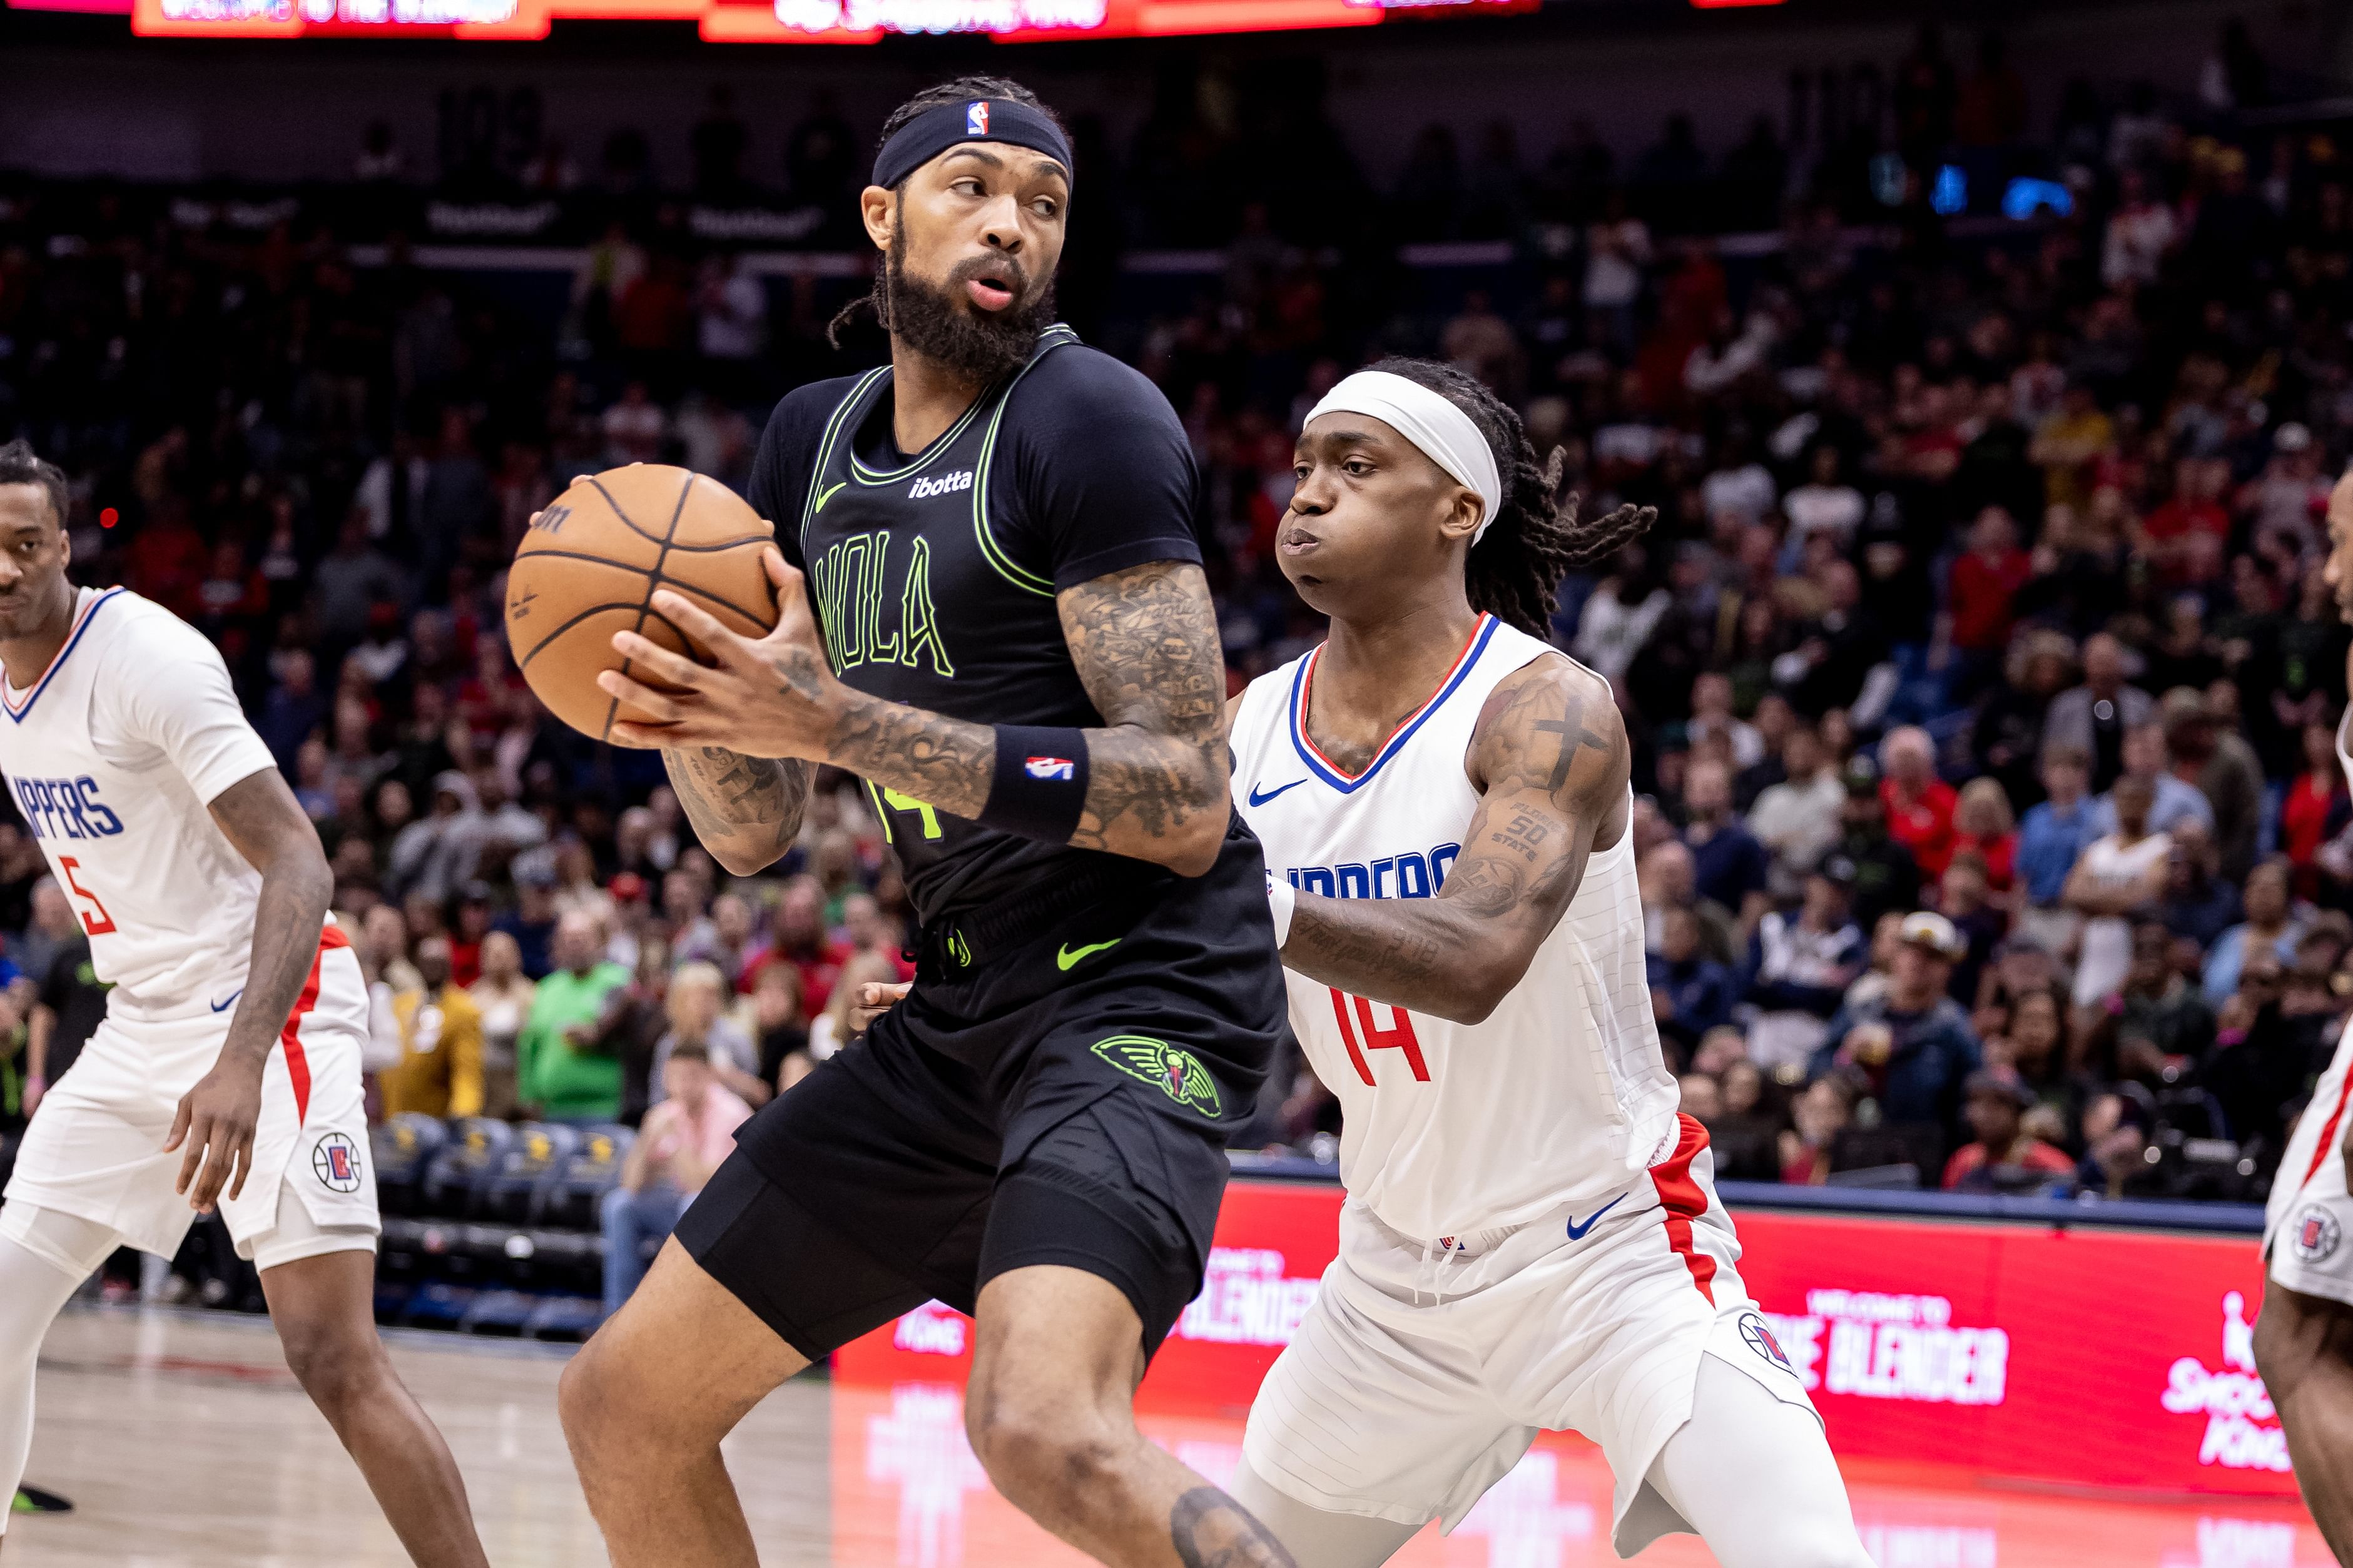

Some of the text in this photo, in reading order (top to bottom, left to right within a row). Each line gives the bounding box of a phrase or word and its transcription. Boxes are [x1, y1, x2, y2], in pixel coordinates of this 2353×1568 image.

[908, 470, 973, 498] ibotta
[815, 530, 955, 678] NOLA
[58, 854, 118, 936] 5
[1826, 1317, 2010, 1406] BLENDER
